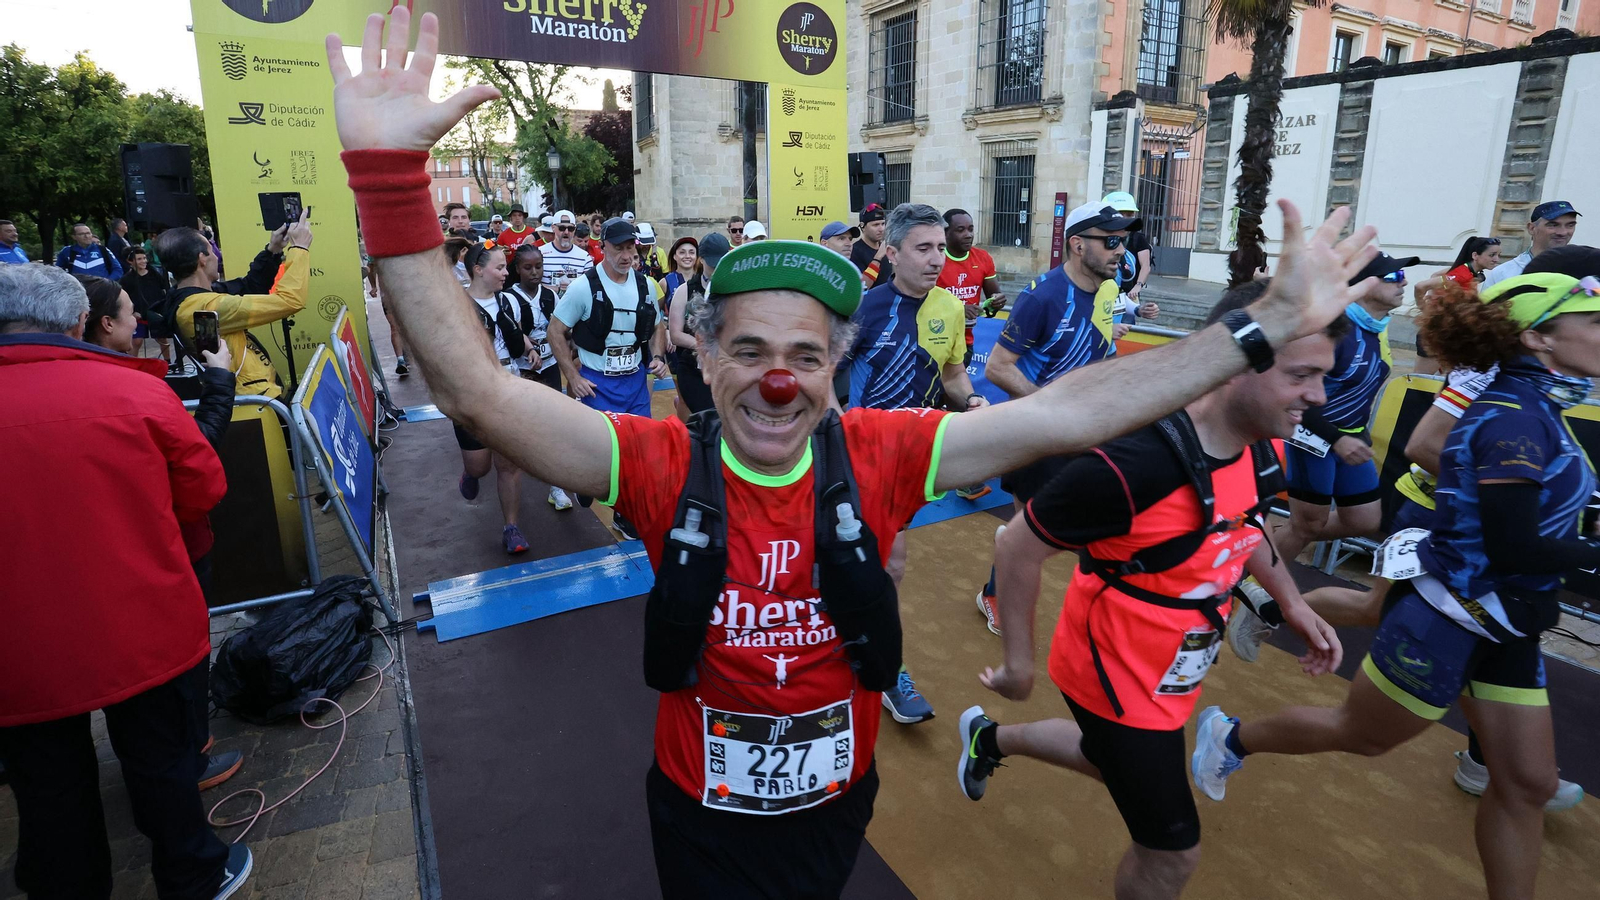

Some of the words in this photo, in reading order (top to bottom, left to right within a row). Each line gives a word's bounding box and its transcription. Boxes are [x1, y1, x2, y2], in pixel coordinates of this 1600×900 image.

[530, 15, 627, 43] Maratón
[781, 29, 833, 54] Sherry
[791, 44, 825, 55] Maratón
[253, 55, 320, 68] Ayuntamiento
[267, 65, 292, 74] Jerez
[269, 103, 325, 115] Diputación
[798, 98, 836, 106] Ayuntamiento
[270, 117, 284, 127] de
[287, 117, 316, 128] Cádiz
[1274, 113, 1317, 129] AZAR
[805, 132, 836, 141] Diputación
[814, 142, 831, 150] Cádiz
[1272, 143, 1302, 156] REZ
[796, 205, 825, 216] HSN
[731, 255, 769, 274] AMOR
[773, 253, 782, 267] Y
[782, 253, 847, 294] ESPERANZA
[319, 295, 345, 311] VALDESPIN
[617, 355, 633, 366] 173
[757, 540, 801, 595] JJP
[709, 590, 825, 630] Sherr
[725, 624, 838, 648] Maratón
[767, 717, 793, 745] JJP
[747, 742, 812, 779] 227
[753, 773, 818, 796] PABLO
